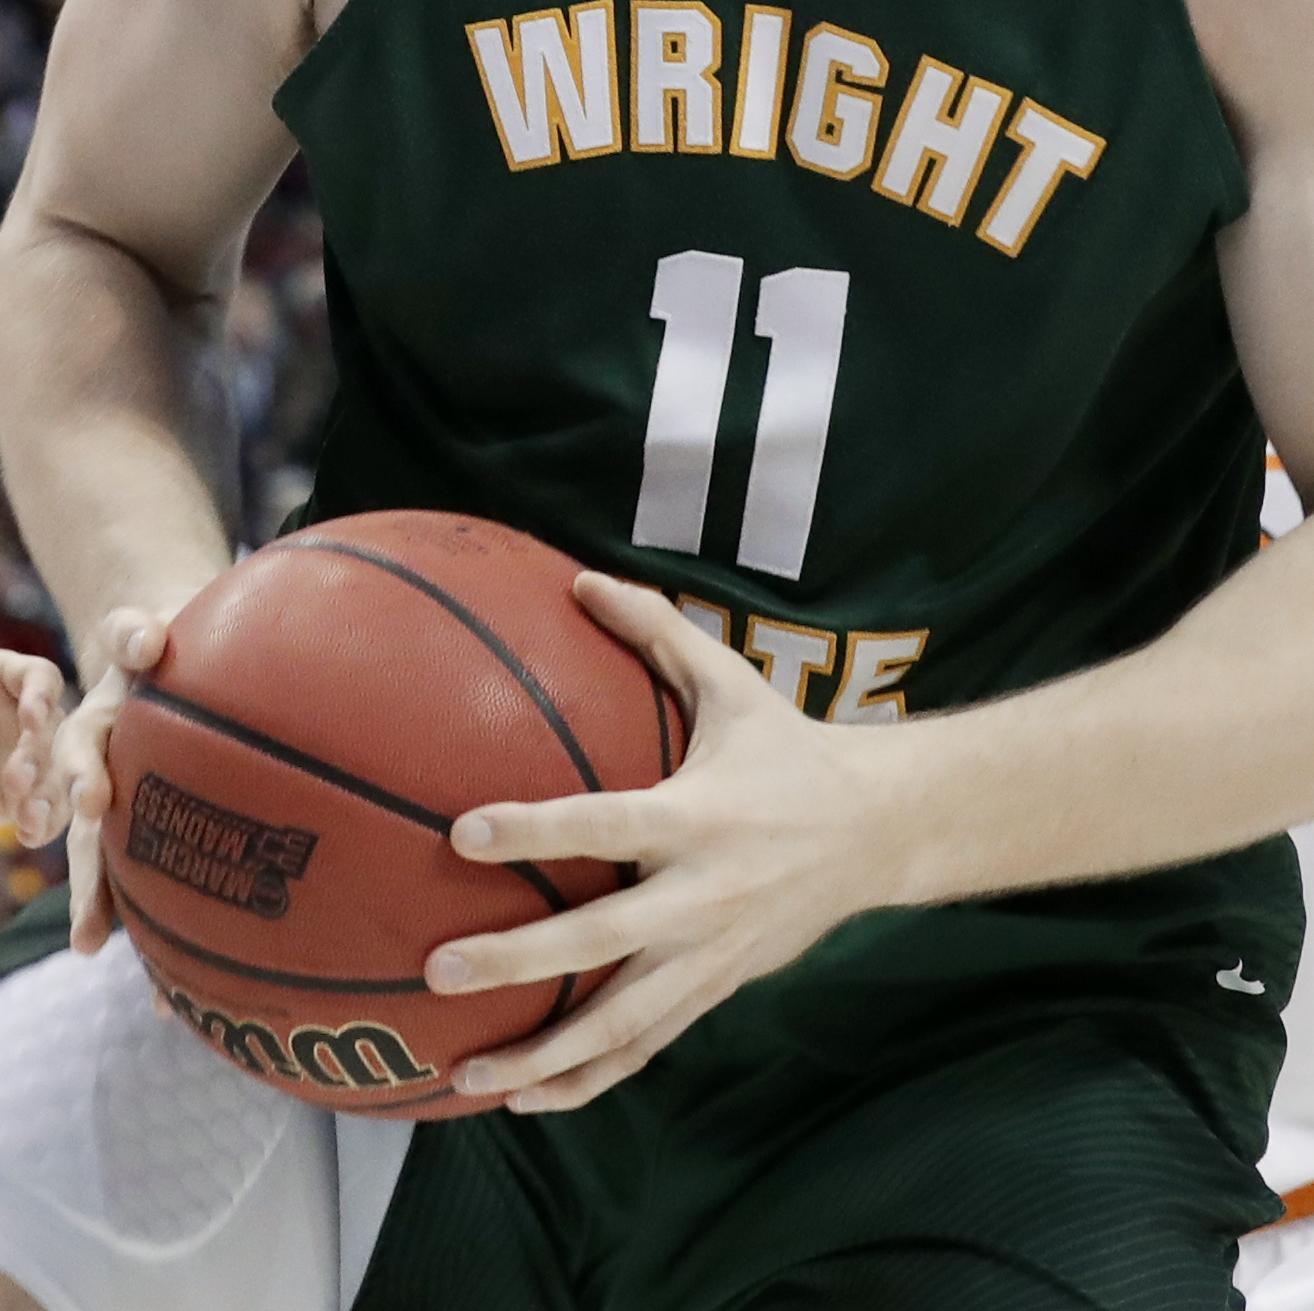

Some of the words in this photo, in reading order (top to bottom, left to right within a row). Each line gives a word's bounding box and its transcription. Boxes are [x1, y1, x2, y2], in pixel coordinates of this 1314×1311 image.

[631, 249, 851, 582] 11
[135, 781, 250, 864] MADNESS
[158, 838, 256, 903] MARCH
